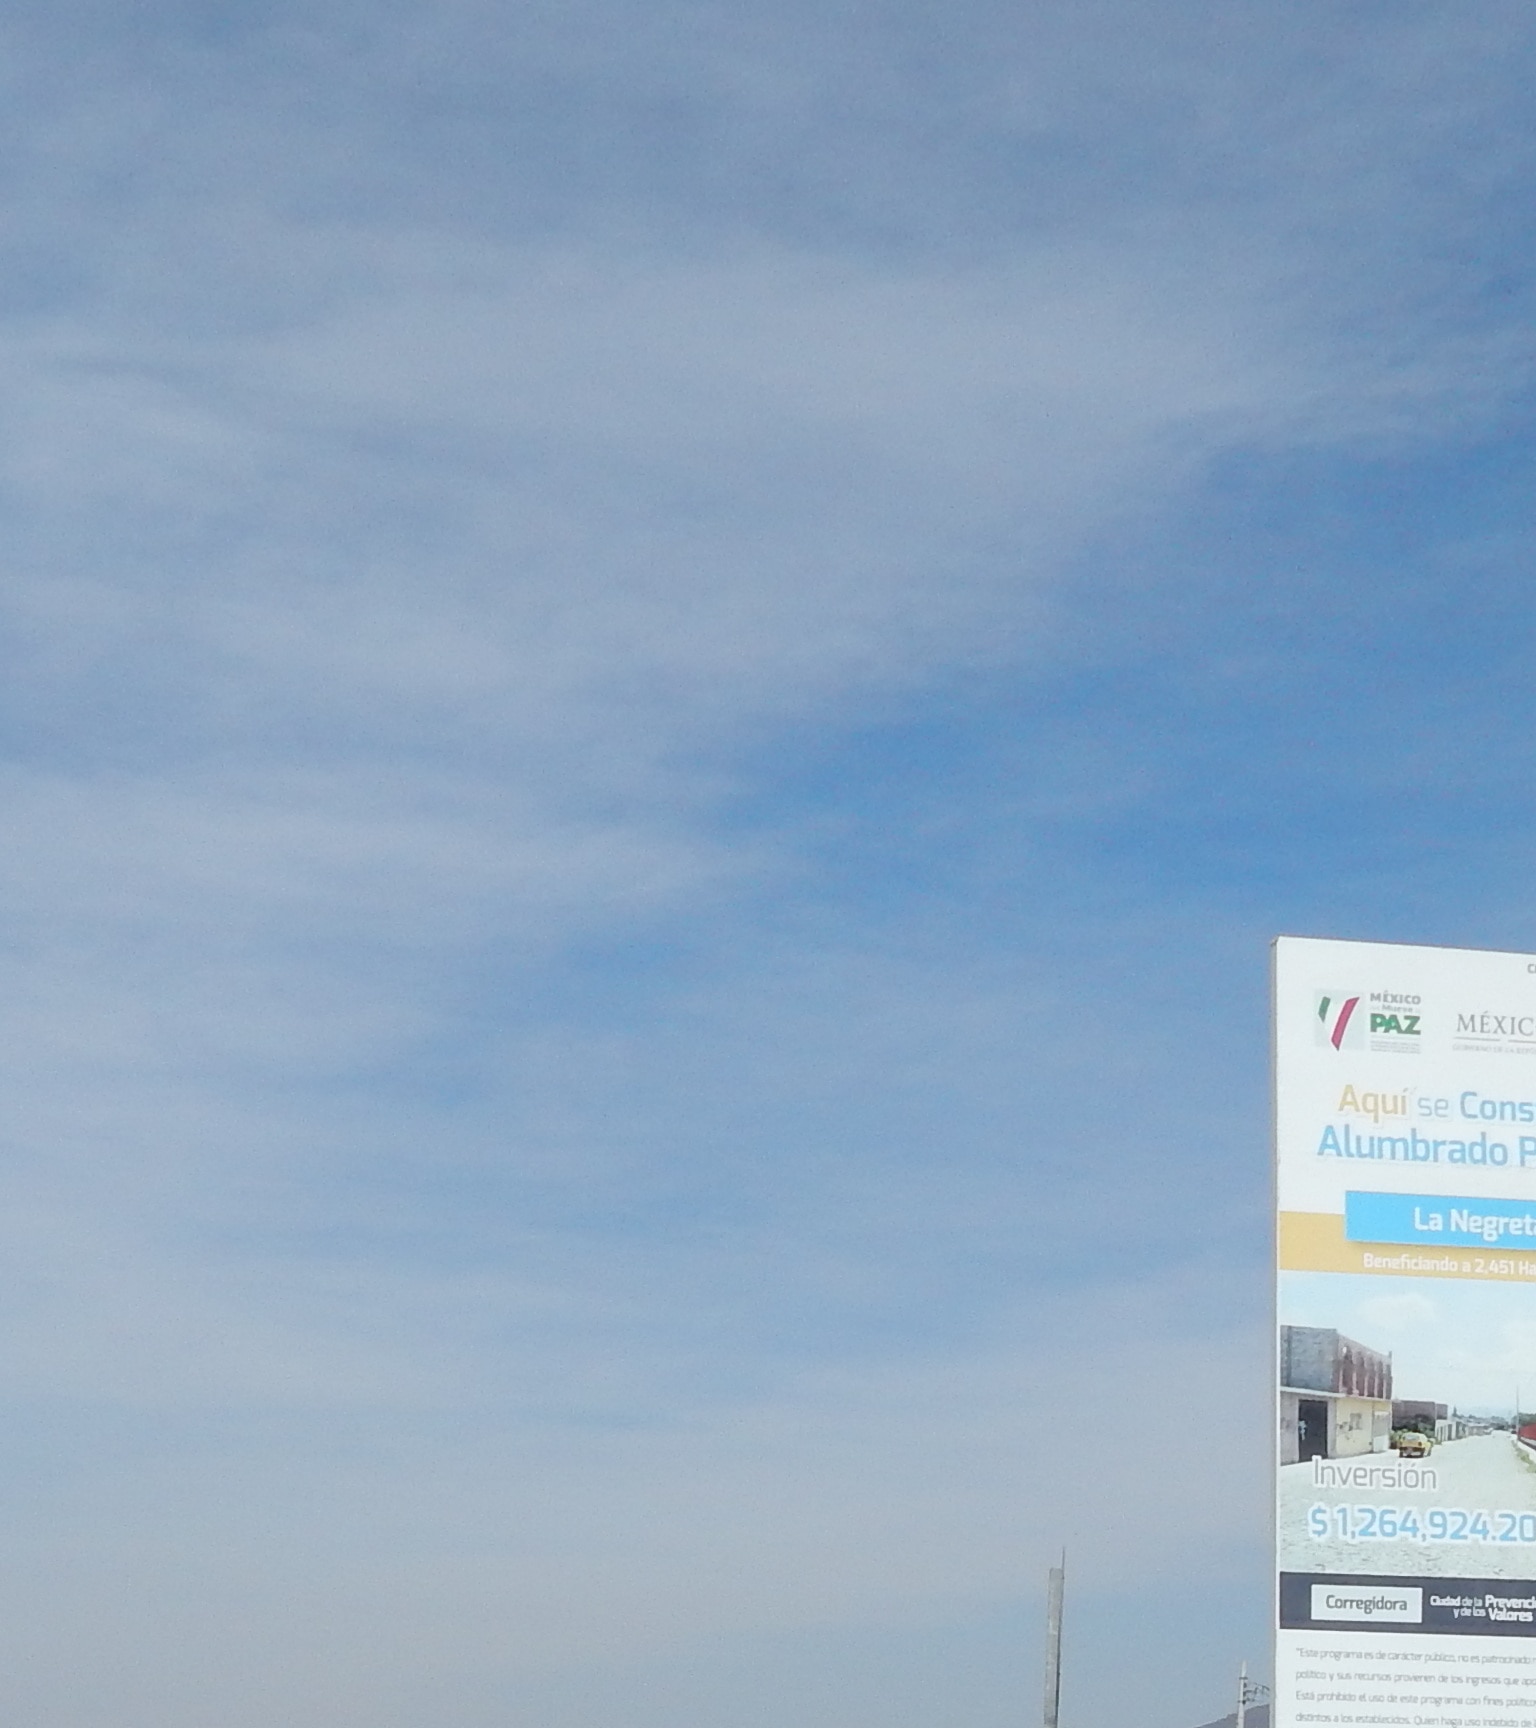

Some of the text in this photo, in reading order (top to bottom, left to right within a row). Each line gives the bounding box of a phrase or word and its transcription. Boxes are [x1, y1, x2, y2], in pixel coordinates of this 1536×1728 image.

[1369, 990, 1421, 1005] MÉXICO
[1369, 1012, 1421, 1036] PAZ
[1338, 1084, 1410, 1125] Aquí
[1418, 1094, 1449, 1118] se
[1317, 1124, 1508, 1166] Alumbrado
[1414, 1207, 1443, 1232] La
[1363, 1253, 1457, 1272] Beneficiando
[1462, 1260, 1471, 1272] a
[1475, 1259, 1515, 1276] 2,451
[1313, 1457, 1437, 1490] Inversión
[1326, 1594, 1408, 1616] Corregidora
[1430, 1595, 1460, 1606] Ciudad
[1453, 1608, 1459, 1618] y
[1488, 1607, 1533, 1621] Valores
